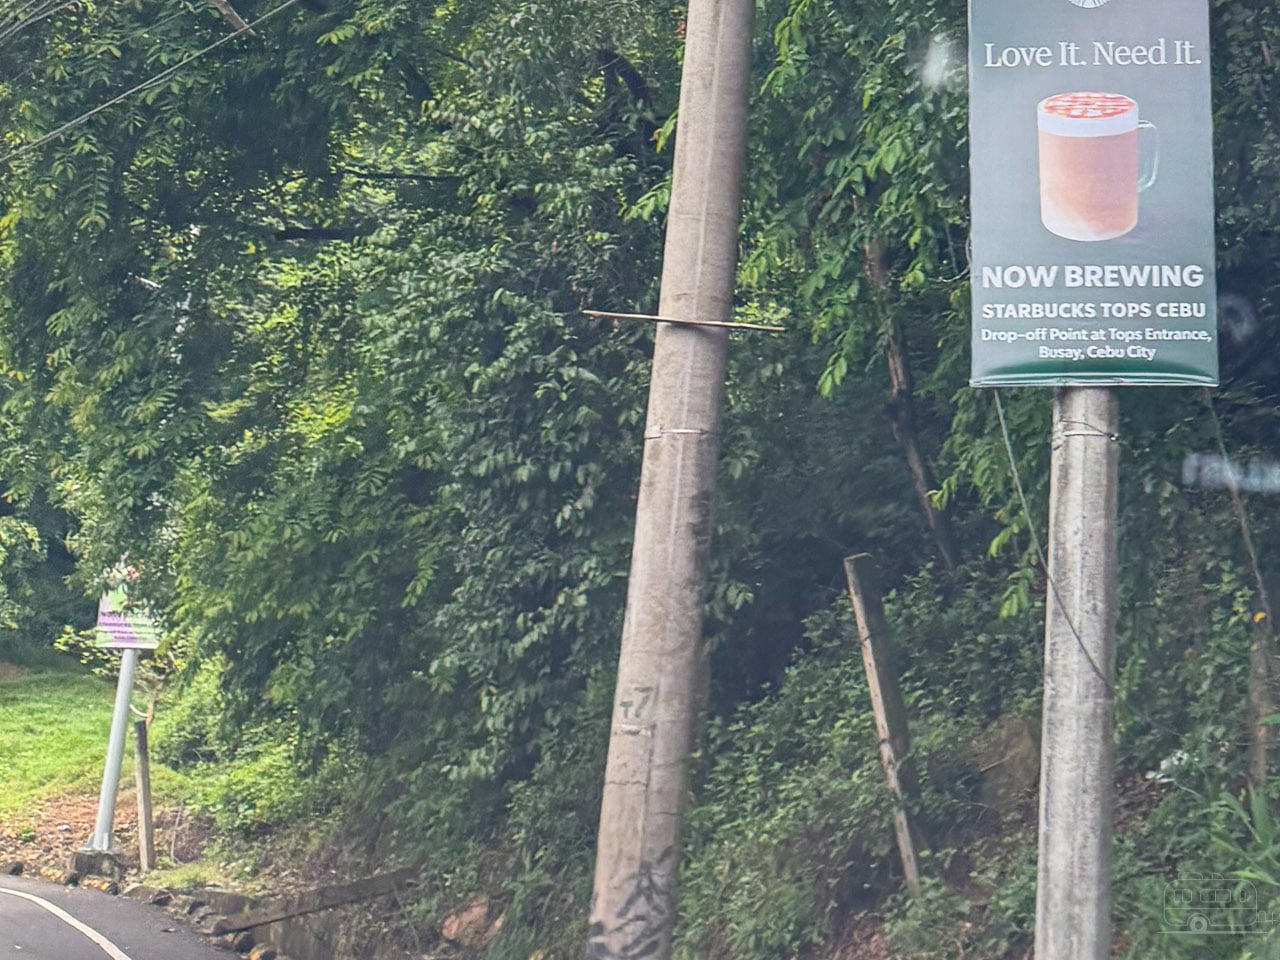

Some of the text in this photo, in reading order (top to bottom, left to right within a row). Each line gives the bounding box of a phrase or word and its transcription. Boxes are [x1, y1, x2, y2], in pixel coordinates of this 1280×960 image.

[984, 38, 1202, 67] Love It. Need It.
[982, 264, 1205, 288] NOW BREWING
[982, 302, 1207, 319] STARBUCKS TOPS CEBU
[981, 327, 1212, 343] Drop-off Point at Tops Entrance,
[1038, 345, 1157, 361] Busay, Cebu City
